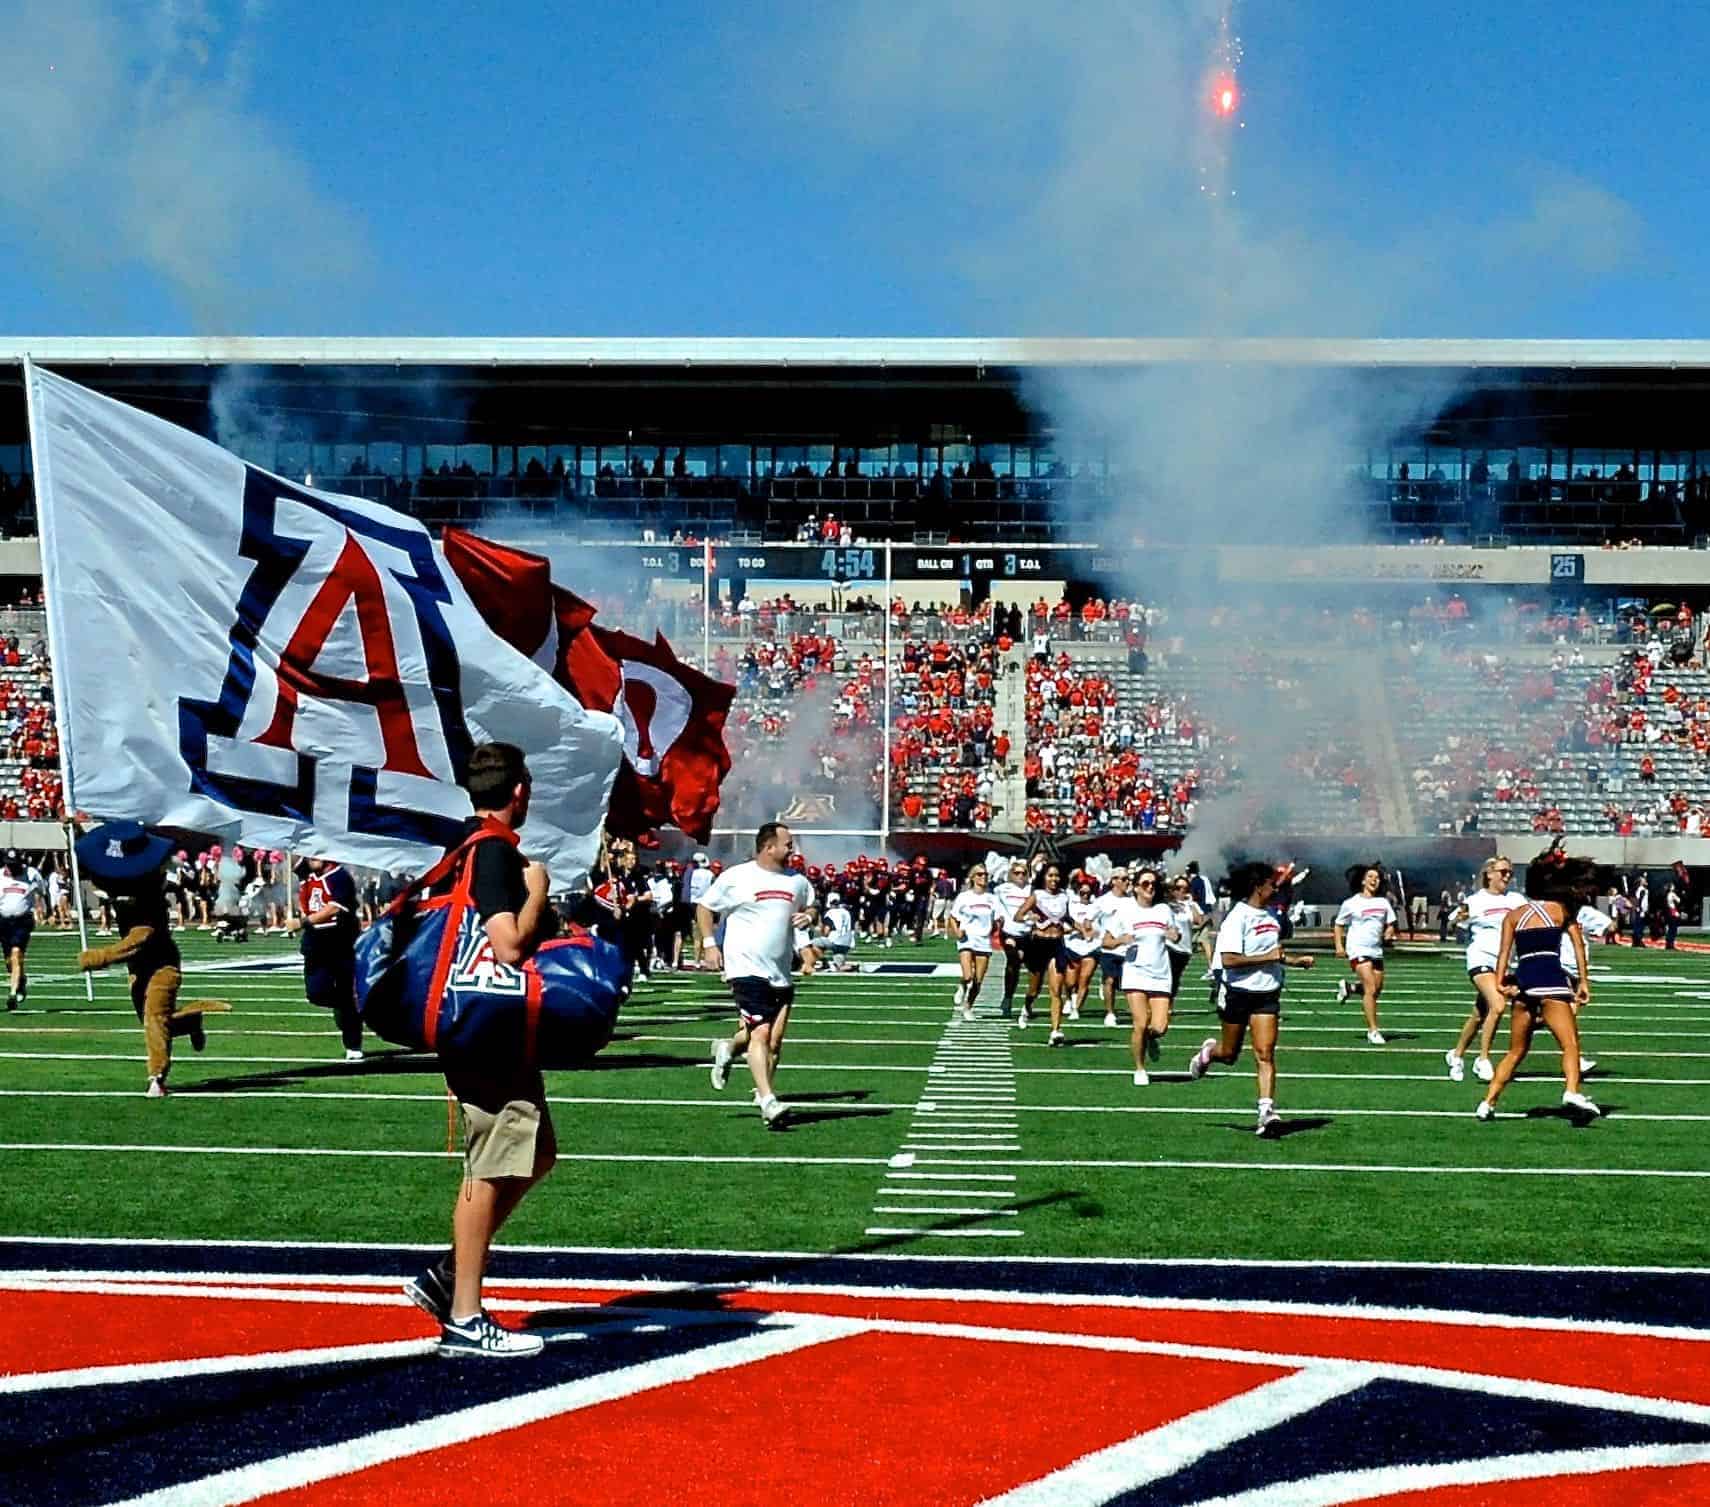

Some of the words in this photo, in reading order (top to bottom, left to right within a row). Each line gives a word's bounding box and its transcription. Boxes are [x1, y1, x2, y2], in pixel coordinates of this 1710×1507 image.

[668, 552, 680, 573] 3
[738, 558, 750, 568] TO
[752, 558, 766, 568] GO
[821, 550, 875, 577] 4:54
[917, 559, 939, 569] BALL
[940, 559, 954, 569] ON
[962, 553, 970, 575] 1
[976, 559, 994, 569] QTR
[1004, 554, 1017, 575] 3
[1553, 556, 1576, 577] 25
[178, 463, 476, 852] A
